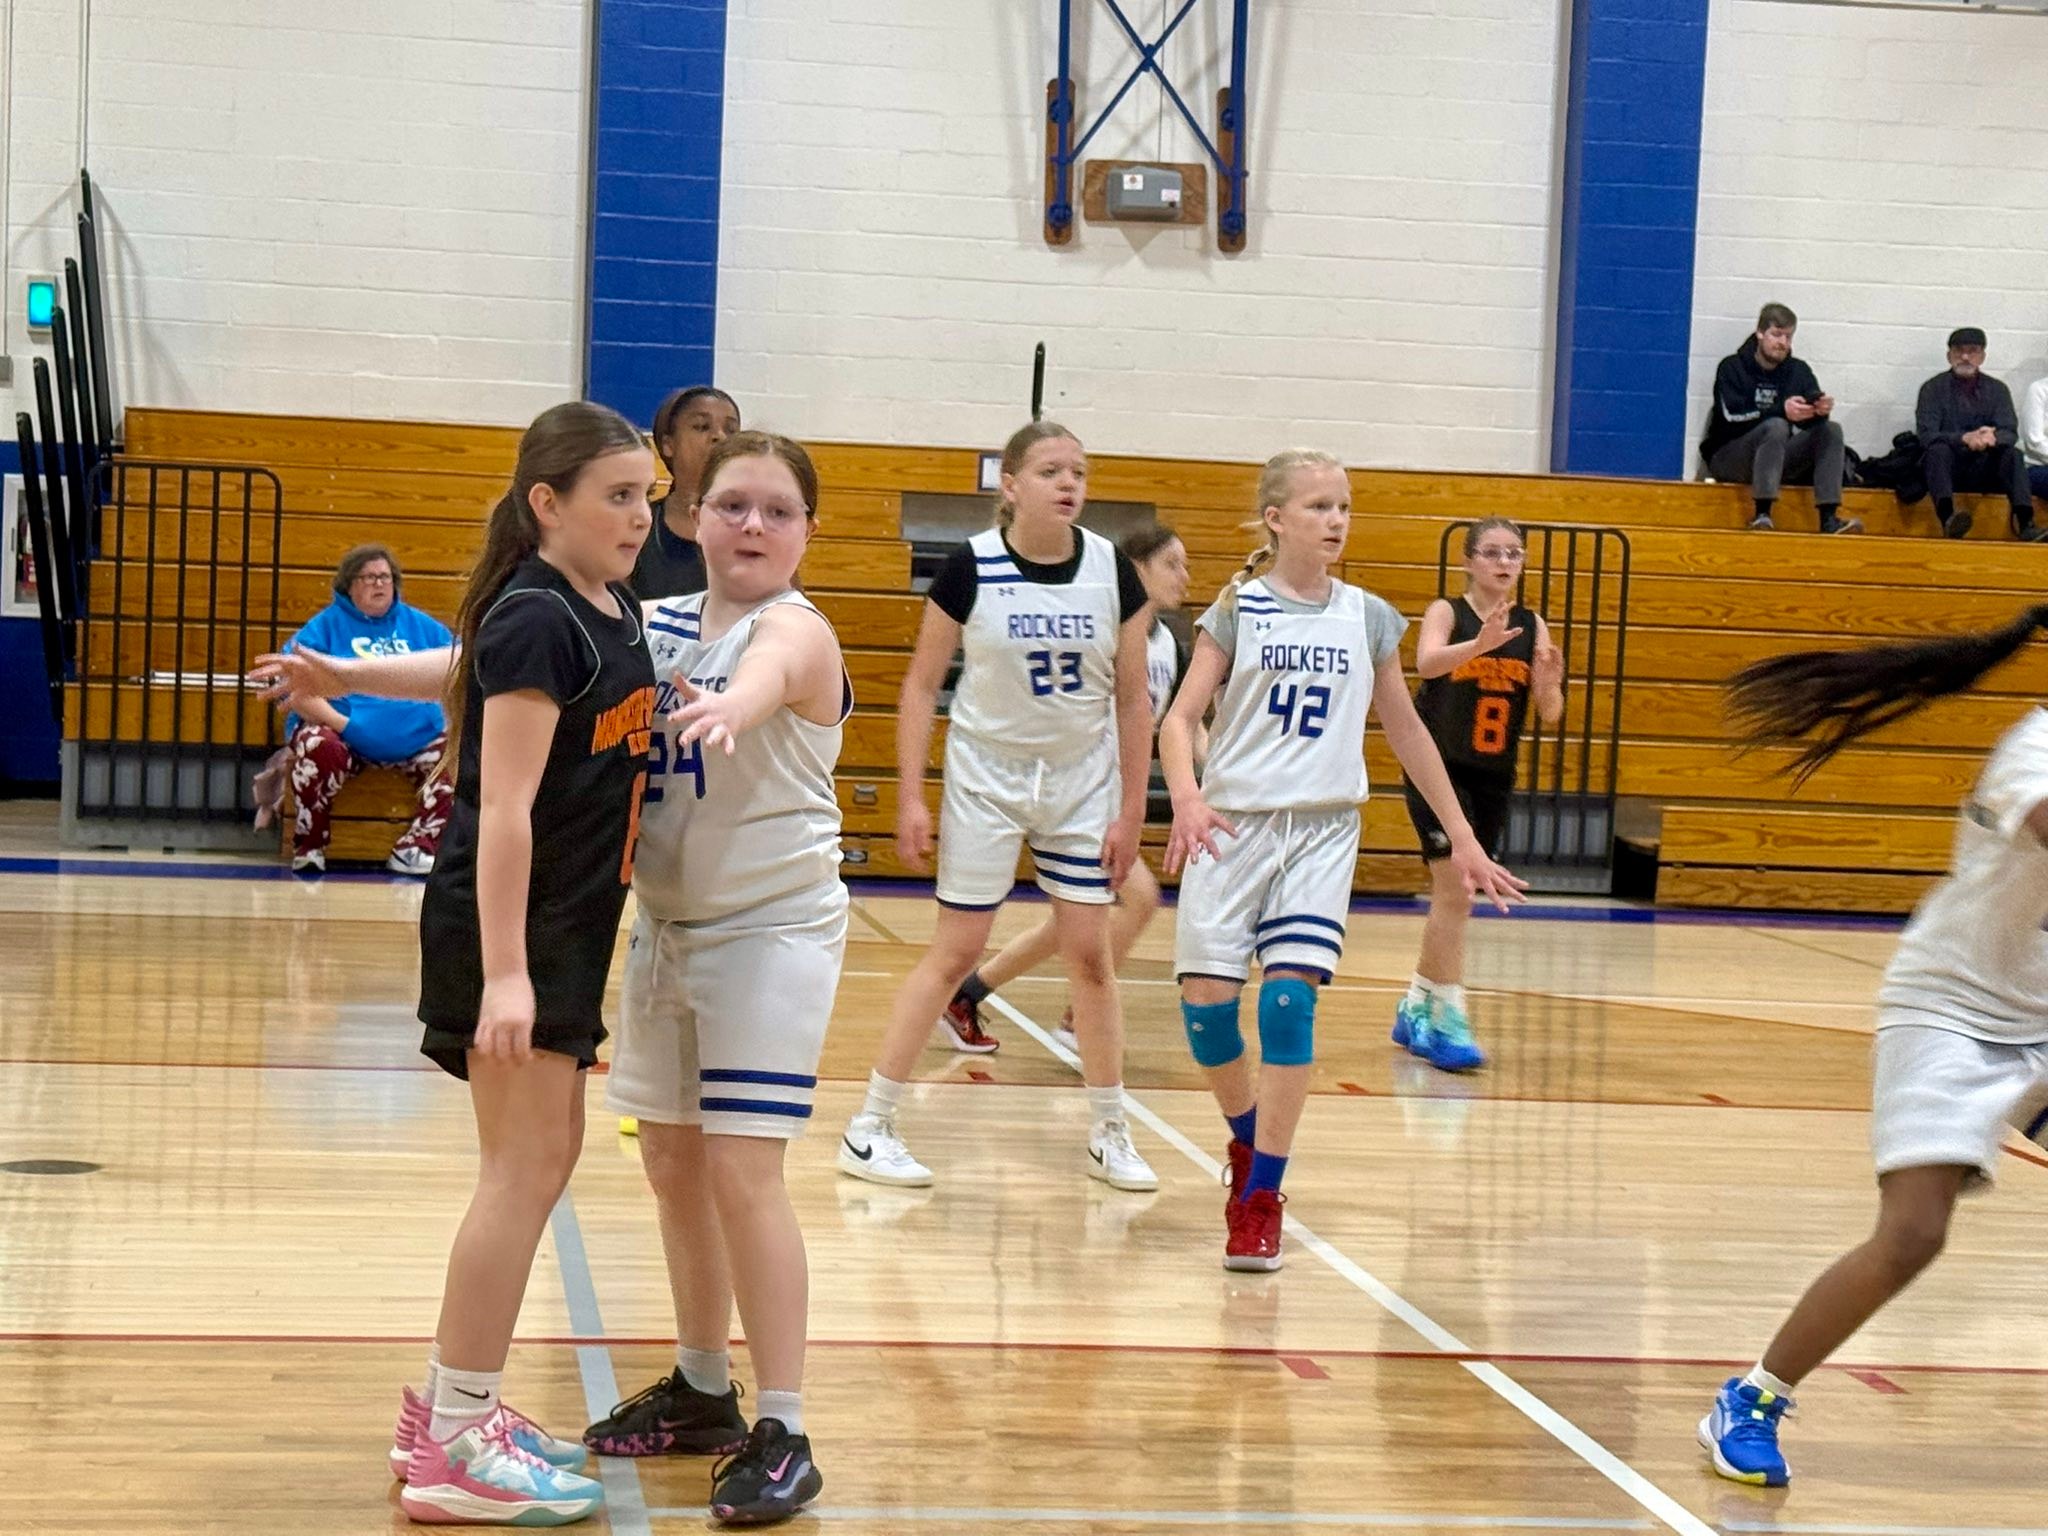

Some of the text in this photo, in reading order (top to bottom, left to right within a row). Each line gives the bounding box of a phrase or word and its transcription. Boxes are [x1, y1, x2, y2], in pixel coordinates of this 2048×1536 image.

[1008, 613, 1095, 639] ROCKETS
[1026, 650, 1083, 696] 23
[1261, 644, 1349, 675] ROCKETS
[1268, 683, 1331, 738] 42
[1472, 696, 1510, 754] 8
[644, 730, 706, 802] 24
